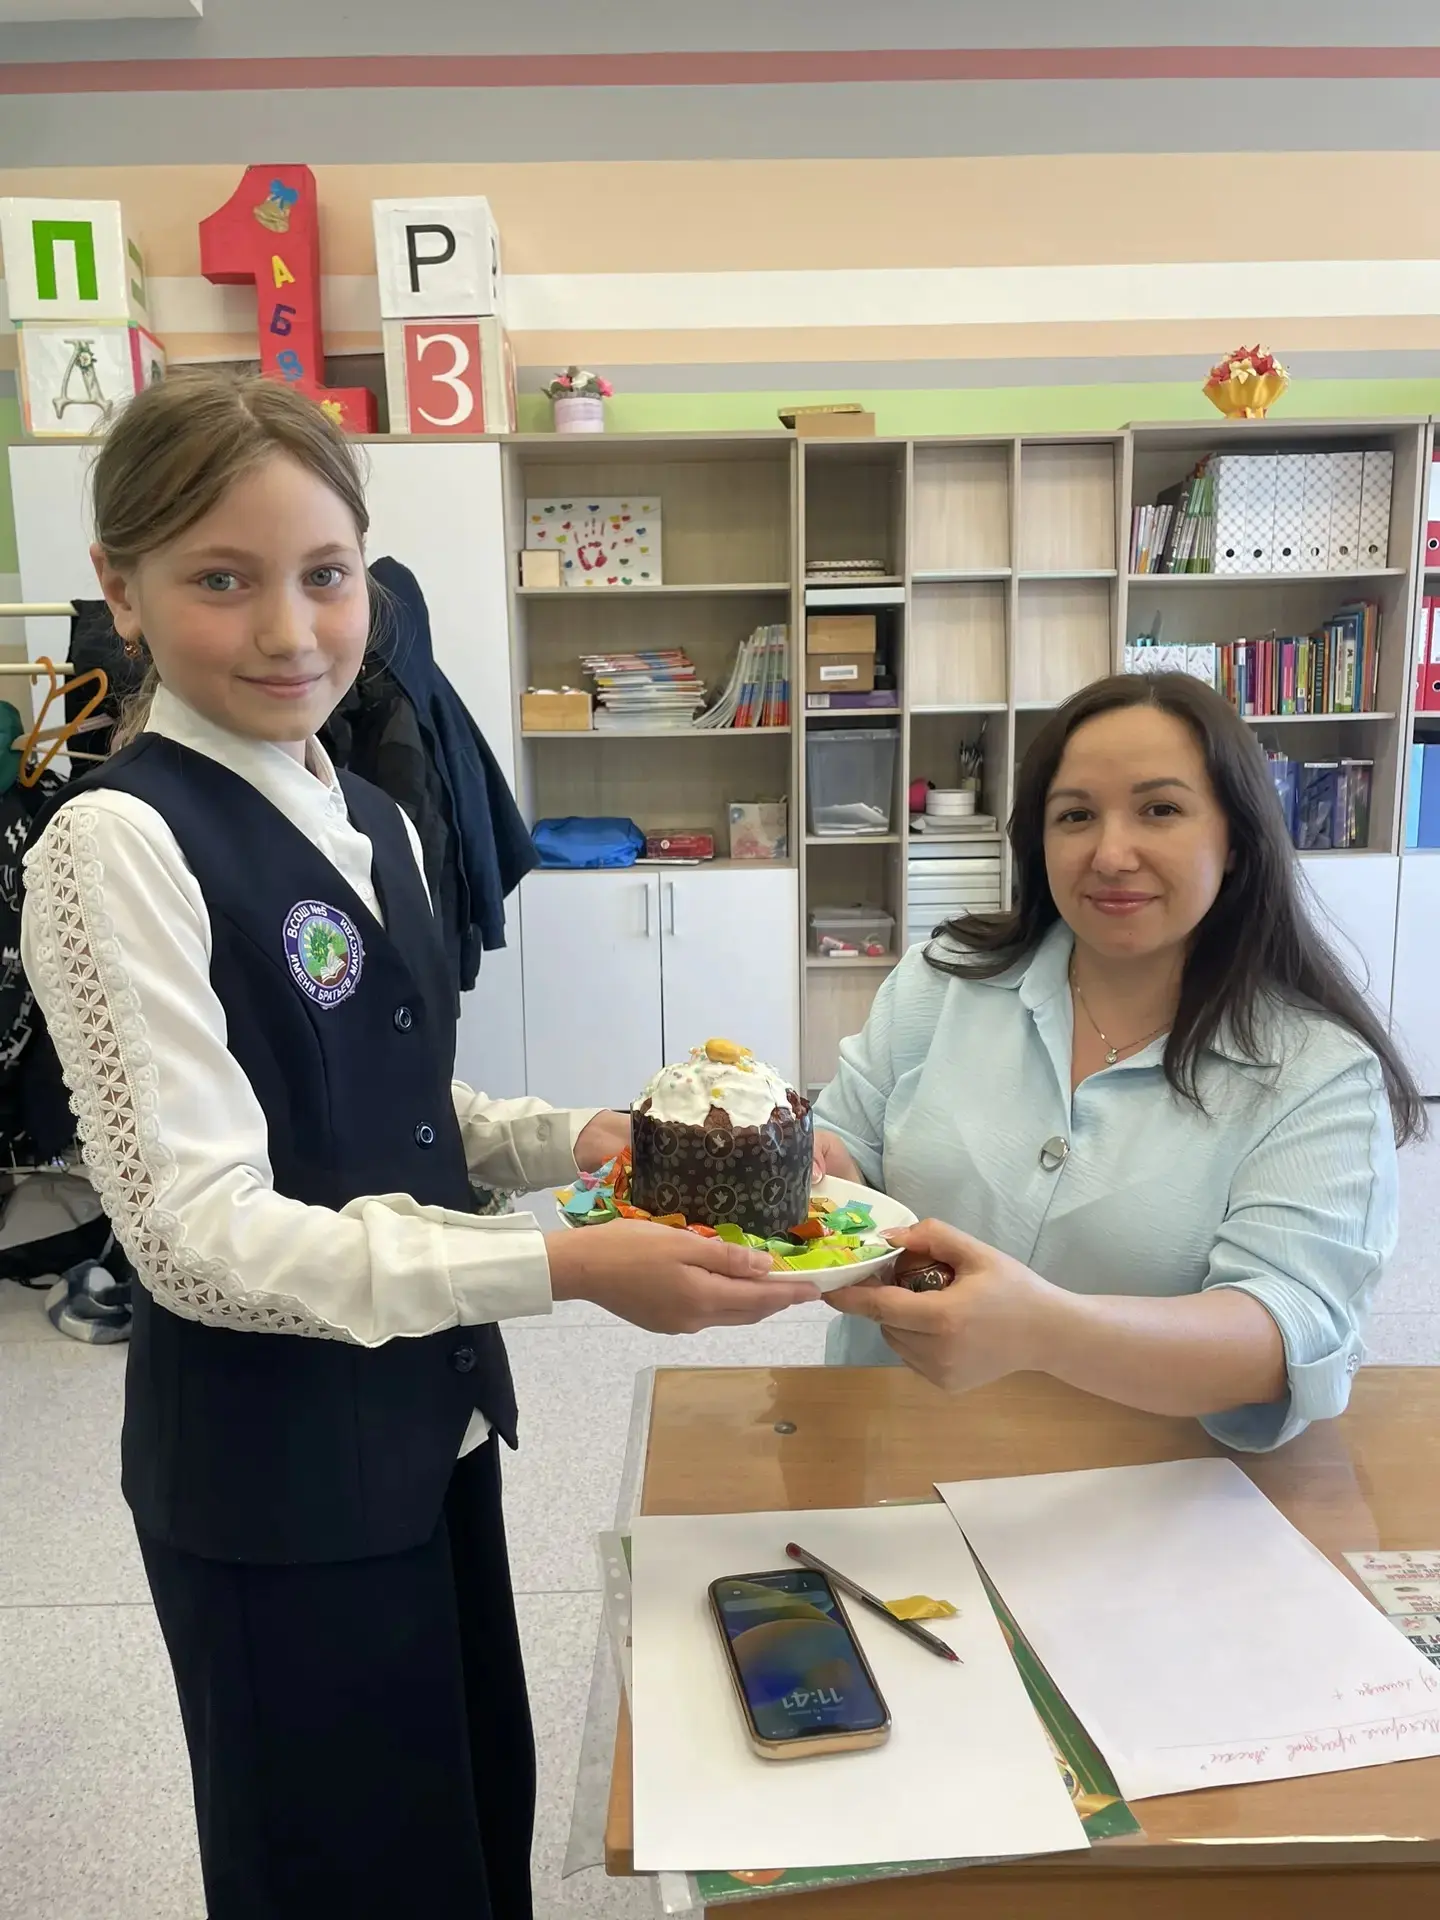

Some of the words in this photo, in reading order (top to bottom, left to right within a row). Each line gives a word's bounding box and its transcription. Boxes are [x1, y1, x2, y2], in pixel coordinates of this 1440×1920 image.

[32, 220, 98, 300] П
[271, 255, 296, 288] А
[270, 303, 297, 336] Б
[276, 348, 305, 382] В
[287, 905, 310, 939] ВСОШ
[290, 953, 316, 996] ИМЕНИ
[317, 977, 352, 1001] БРАТЬЕВ
[339, 917, 360, 976] МАКСУДИ
[781, 1687, 844, 1709] 11:41
